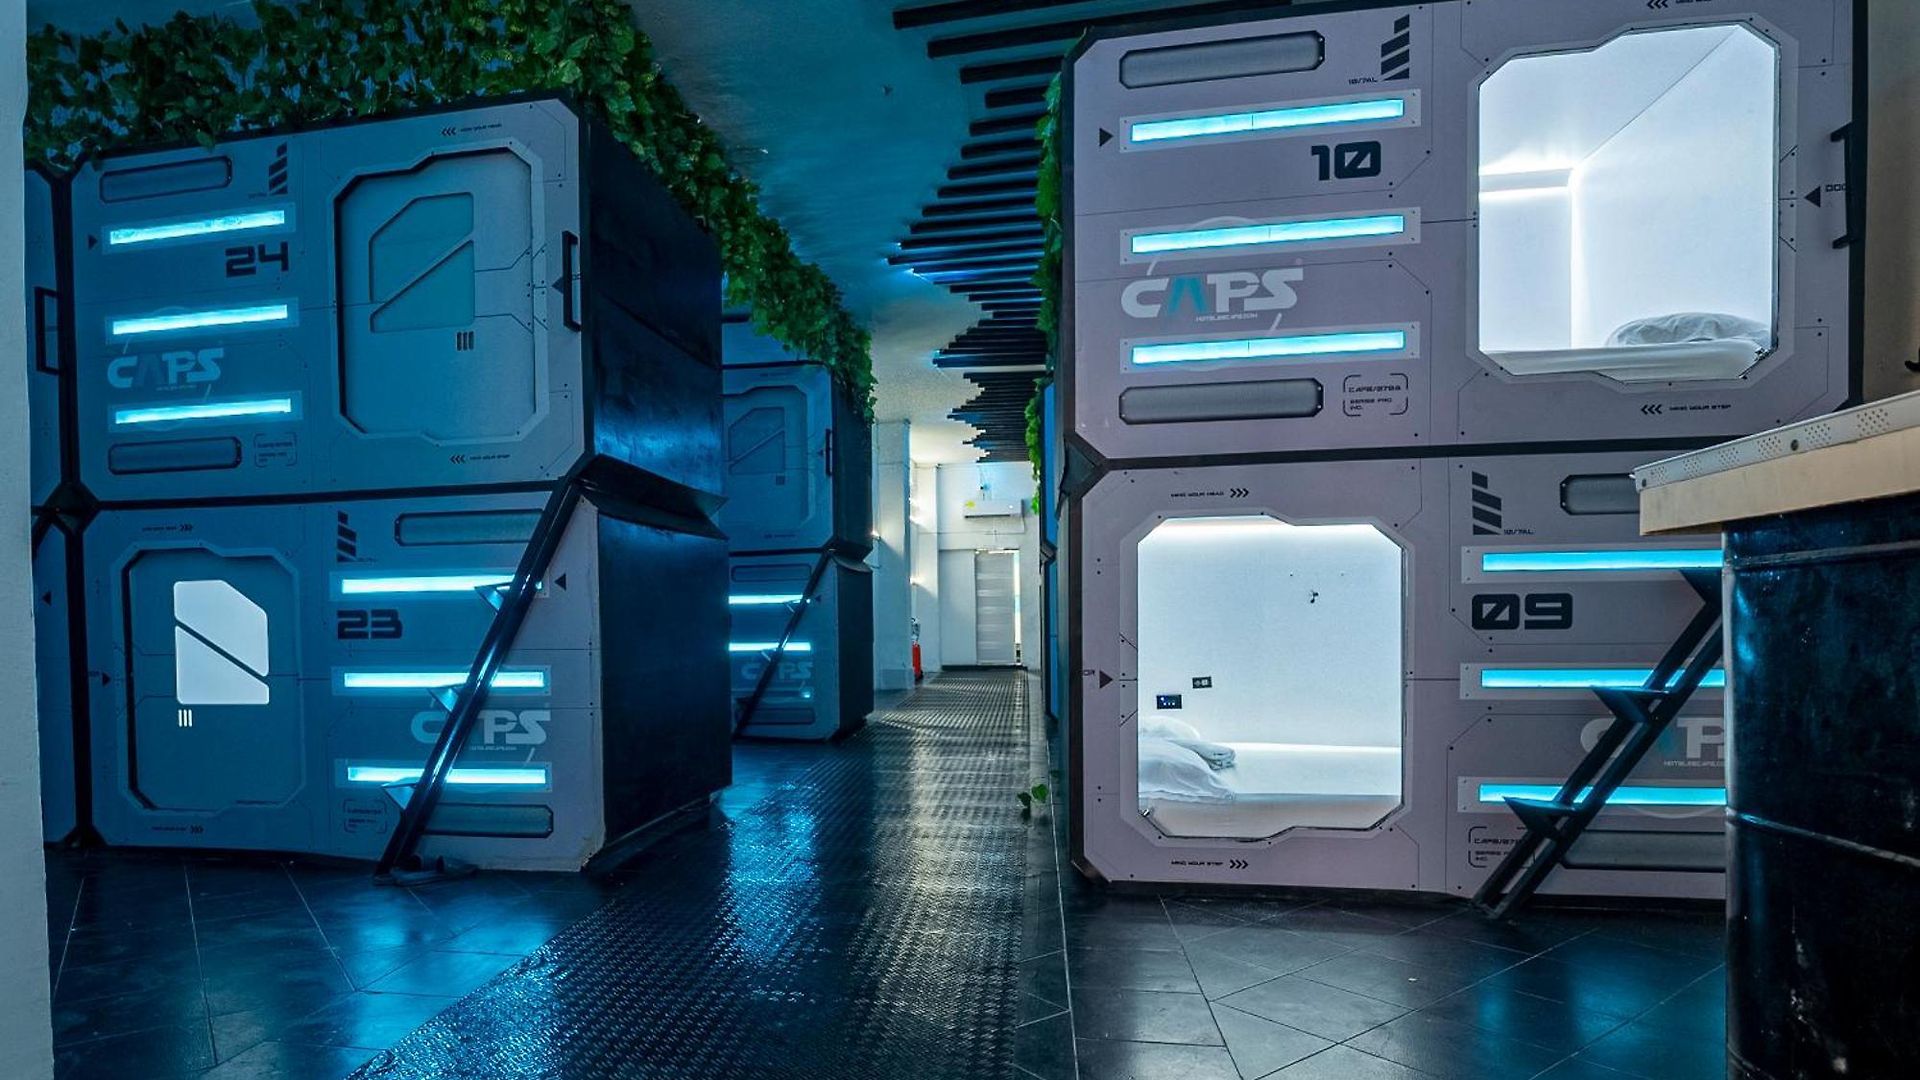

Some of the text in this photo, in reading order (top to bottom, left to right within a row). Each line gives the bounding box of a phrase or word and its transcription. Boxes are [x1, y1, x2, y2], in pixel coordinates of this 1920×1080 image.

[1311, 141, 1381, 181] 10
[225, 241, 289, 278] 24
[1120, 268, 1304, 318] CAPS
[337, 609, 403, 640] 23
[1472, 593, 1573, 630] 09
[741, 661, 814, 681] CPS
[411, 709, 552, 745] CPS
